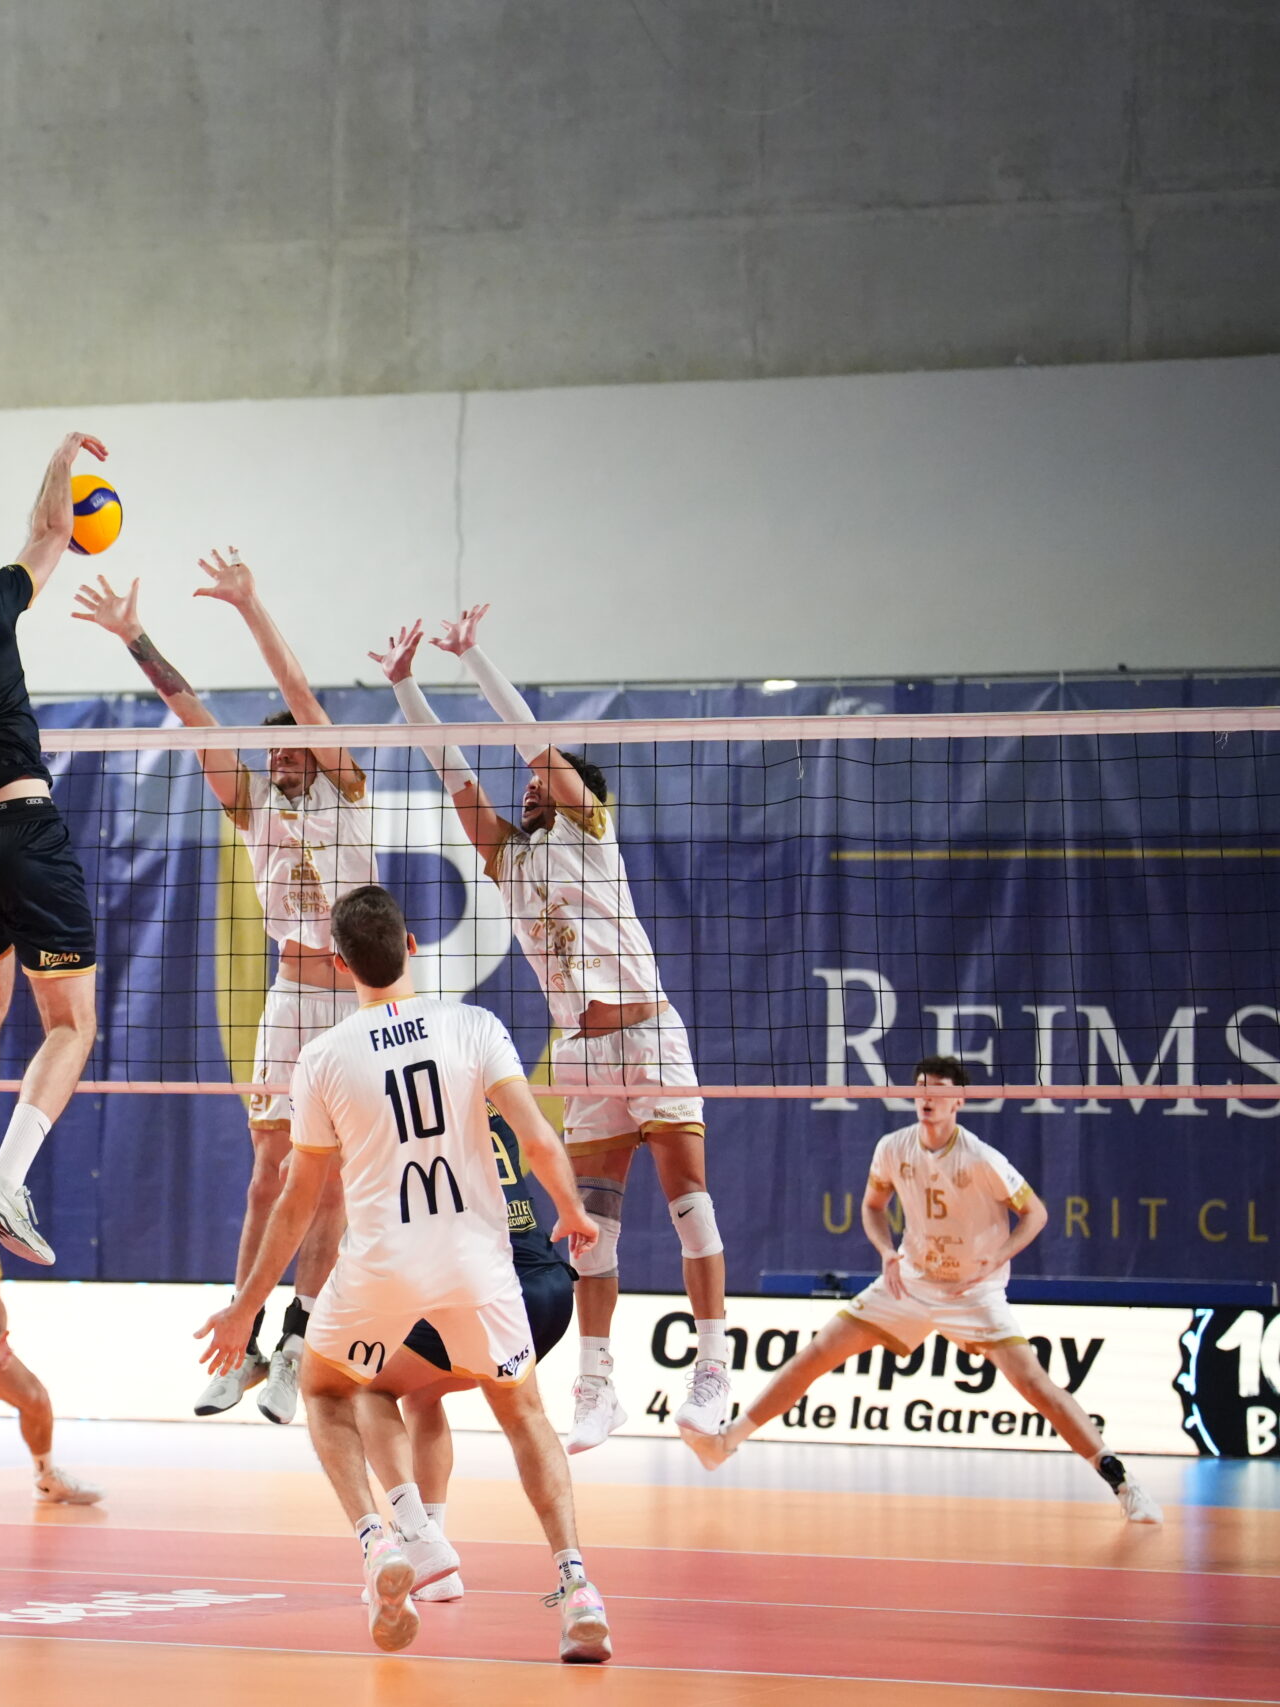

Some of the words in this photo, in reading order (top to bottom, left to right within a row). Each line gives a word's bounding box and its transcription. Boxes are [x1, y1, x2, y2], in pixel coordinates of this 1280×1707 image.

[369, 1017, 429, 1051] FAURE
[810, 967, 1280, 1119] REIMS
[385, 1059, 445, 1145] 10
[925, 1187, 948, 1220] 15
[646, 1390, 670, 1423] 4
[782, 1395, 837, 1429] de
[850, 1396, 889, 1431] la
[904, 1399, 1106, 1437] Garene
